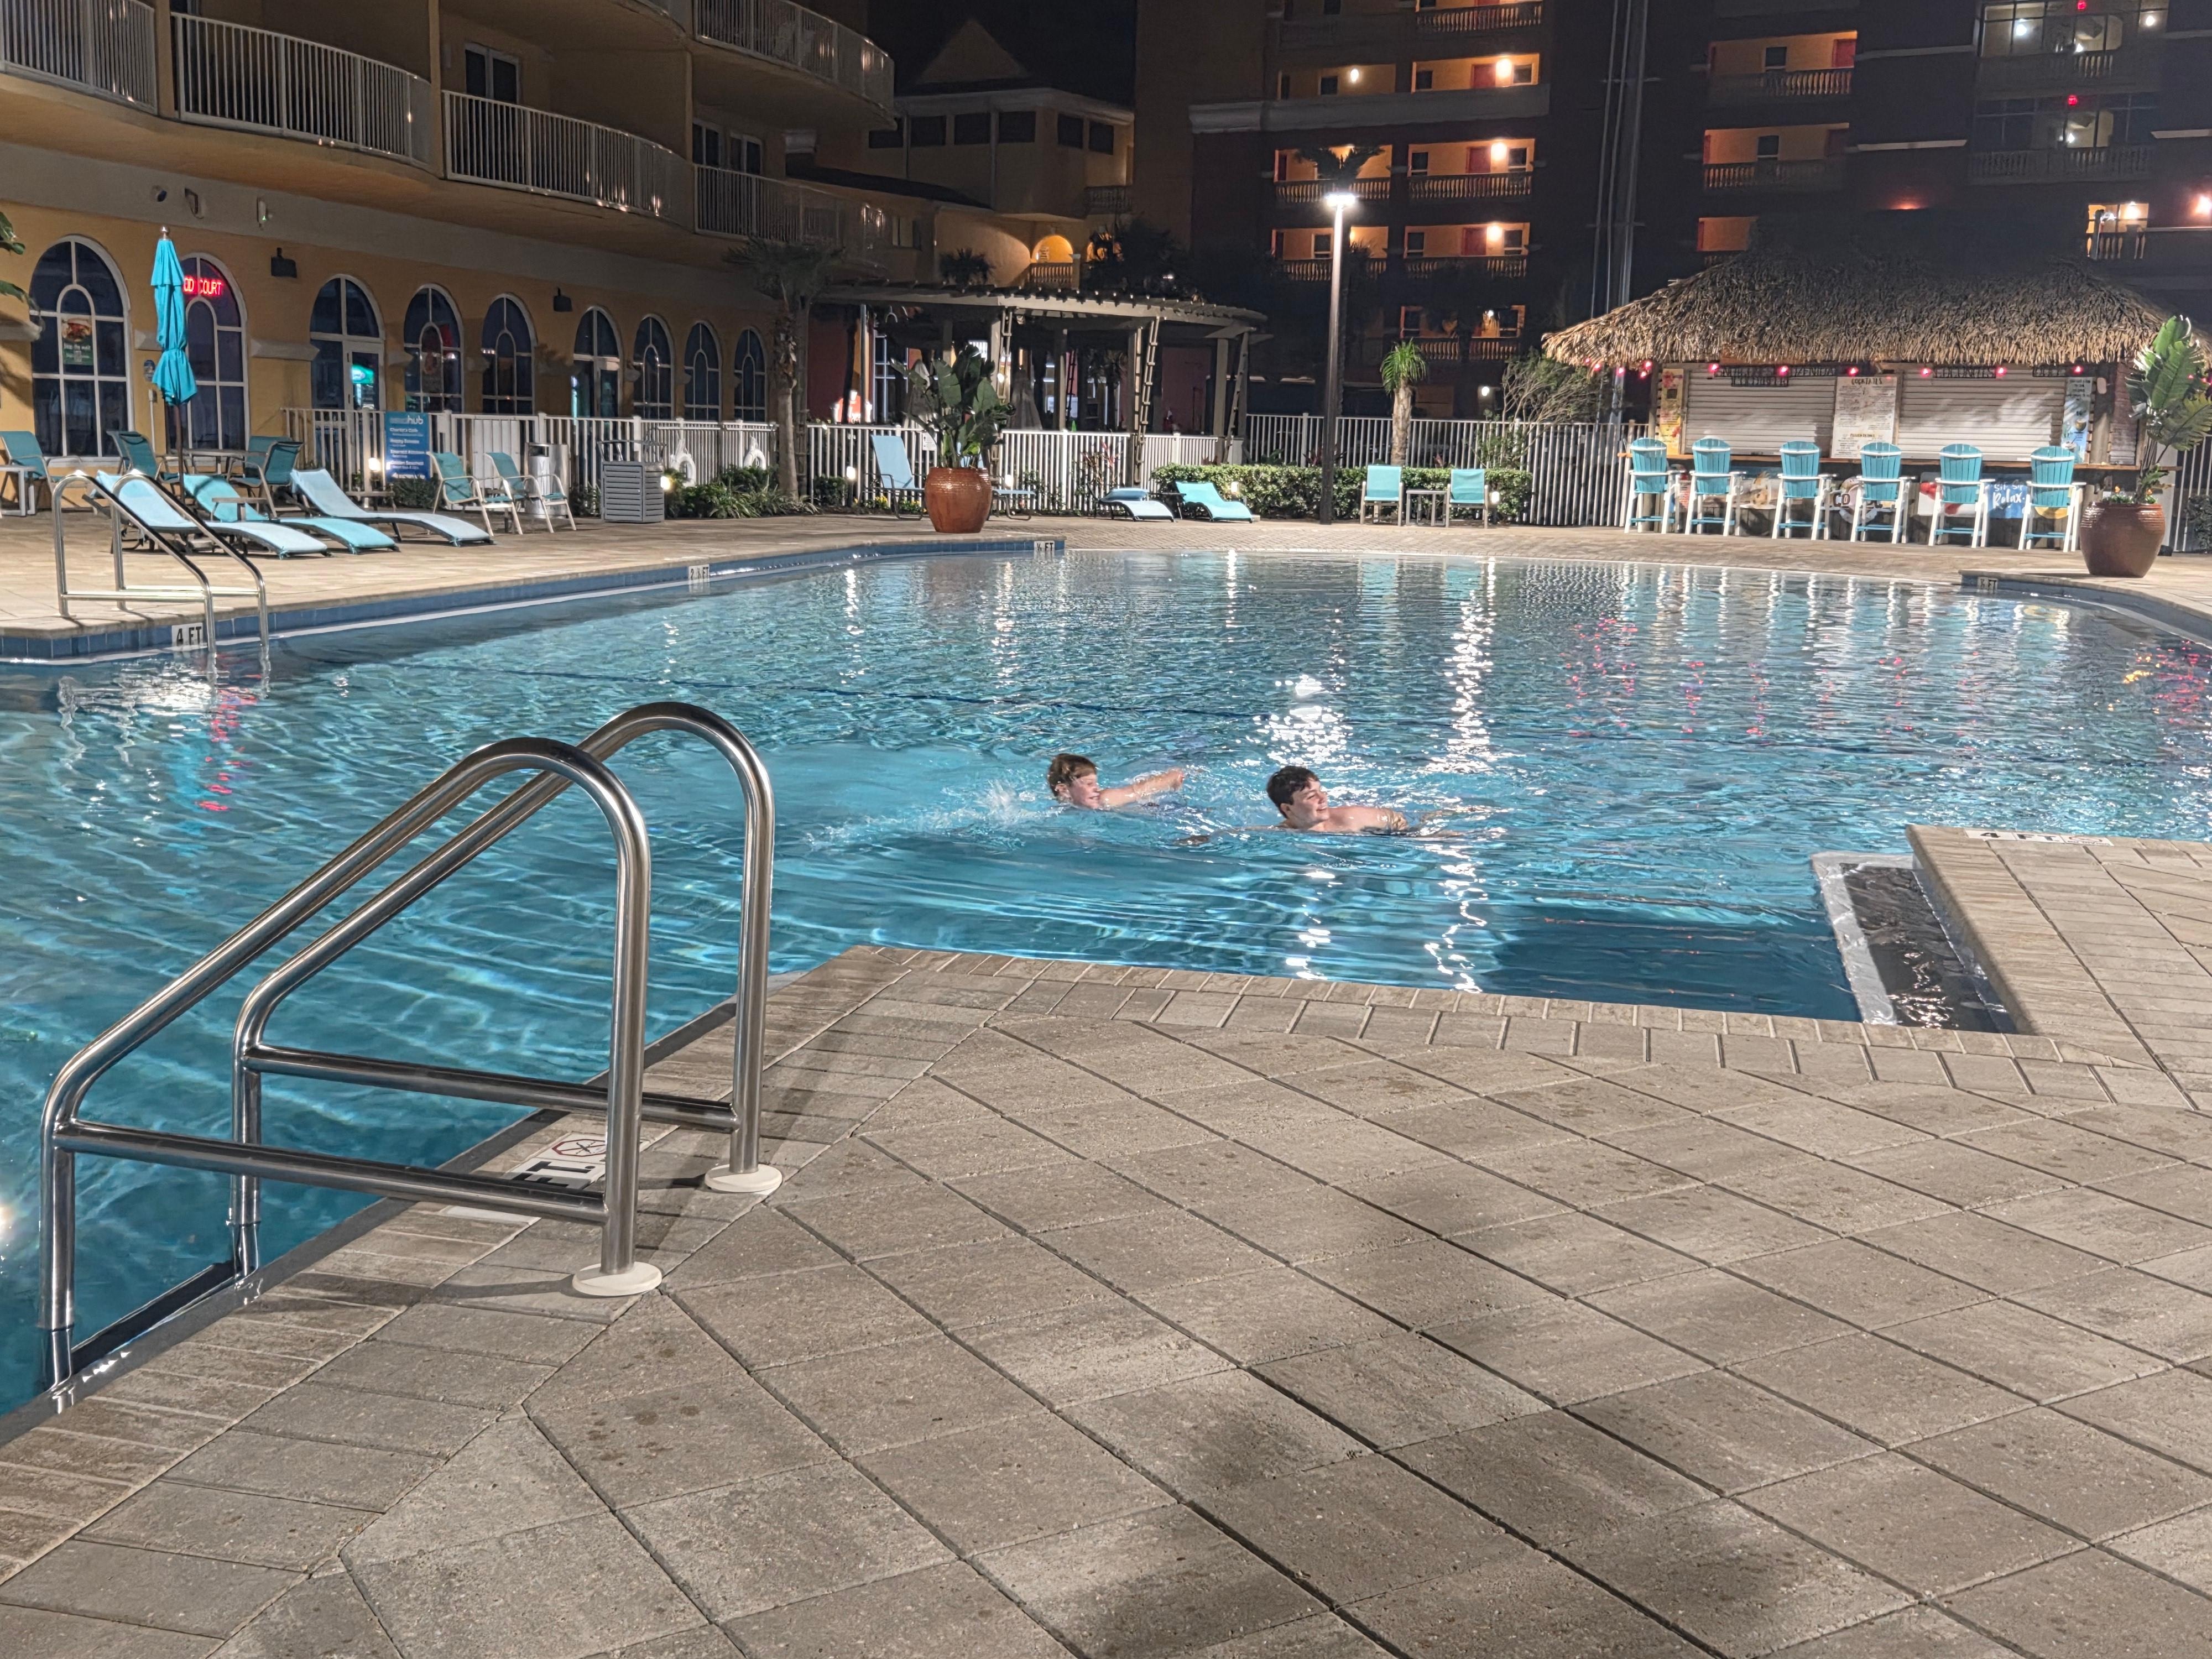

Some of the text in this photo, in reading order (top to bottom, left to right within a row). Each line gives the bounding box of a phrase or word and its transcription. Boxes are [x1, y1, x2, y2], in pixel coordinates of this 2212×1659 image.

[1045, 542, 1054, 551] FT
[702, 567, 709, 579] FT
[176, 626, 202, 646] 4 FT
